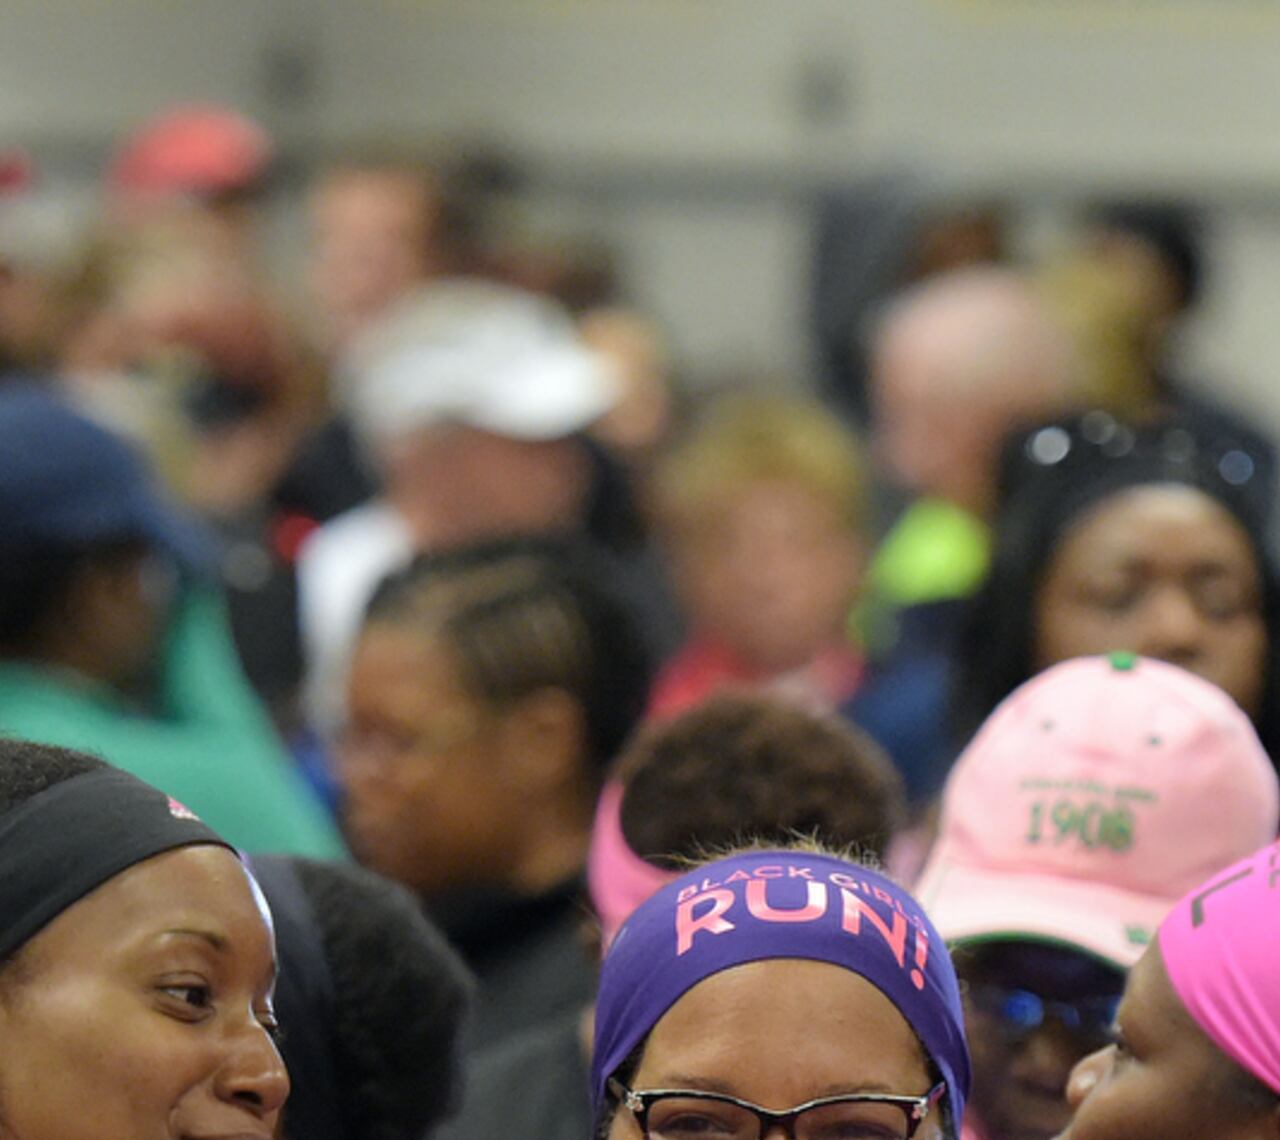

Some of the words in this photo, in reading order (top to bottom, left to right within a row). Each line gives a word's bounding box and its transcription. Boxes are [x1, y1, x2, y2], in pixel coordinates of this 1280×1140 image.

[676, 880, 930, 991] RUN!
[677, 865, 812, 904] BLACK
[829, 872, 929, 938] GIRLS
